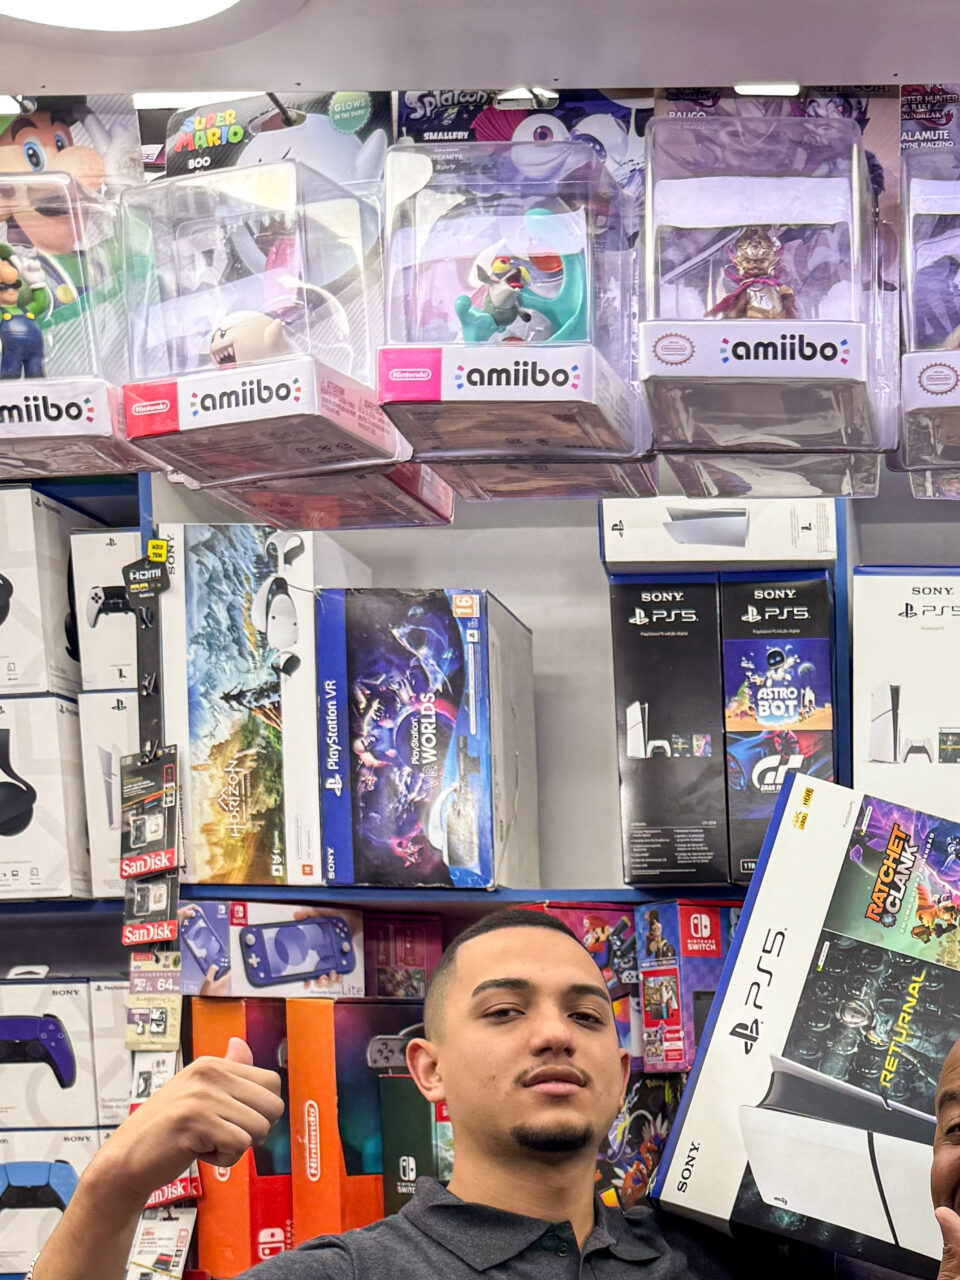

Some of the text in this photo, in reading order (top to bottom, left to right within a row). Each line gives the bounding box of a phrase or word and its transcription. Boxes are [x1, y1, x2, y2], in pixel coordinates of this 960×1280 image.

[333, 99, 366, 112] GLOWS
[183, 109, 237, 131] SUPER
[174, 124, 245, 152] MARIO
[423, 131, 469, 140] SMALLFRY
[901, 130, 949, 141] ALAMUTE
[188, 156, 211, 170] BOO
[731, 334, 839, 361] amiibo
[392, 370, 429, 380] Nintendo
[466, 360, 570, 387] amiibo
[200, 379, 292, 412] amiibo
[0, 396, 83, 424] miibo
[133, 402, 170, 413] Nintendo
[167, 533, 176, 575] SONY
[129, 569, 161, 581] HDMI
[641, 592, 684, 602] SONY
[754, 590, 797, 600] SONY
[912, 586, 955, 595] SONY
[456, 597, 472, 616] 16
[653, 610, 699, 622] PS5
[765, 607, 811, 620] PS5
[758, 687, 798, 701] ASTRO
[759, 700, 798, 717] BOT
[326, 680, 340, 770] PlayStation VR
[420, 692, 436, 764] WORLDS
[411, 717, 419, 765] PlayStation
[224, 760, 247, 837] HORIZON
[121, 852, 171, 877] SanDisk
[327, 847, 335, 879] SONY
[866, 823, 908, 922] RATCHET
[886, 842, 919, 914] CLANK
[123, 925, 174, 944] SanDisk
[745, 927, 784, 1011] PS5
[880, 969, 927, 1088] RETURNAL
[308, 1106, 318, 1176] Nintendo
[677, 1141, 700, 1194] SONY
[149, 1179, 186, 1201] anDisk
